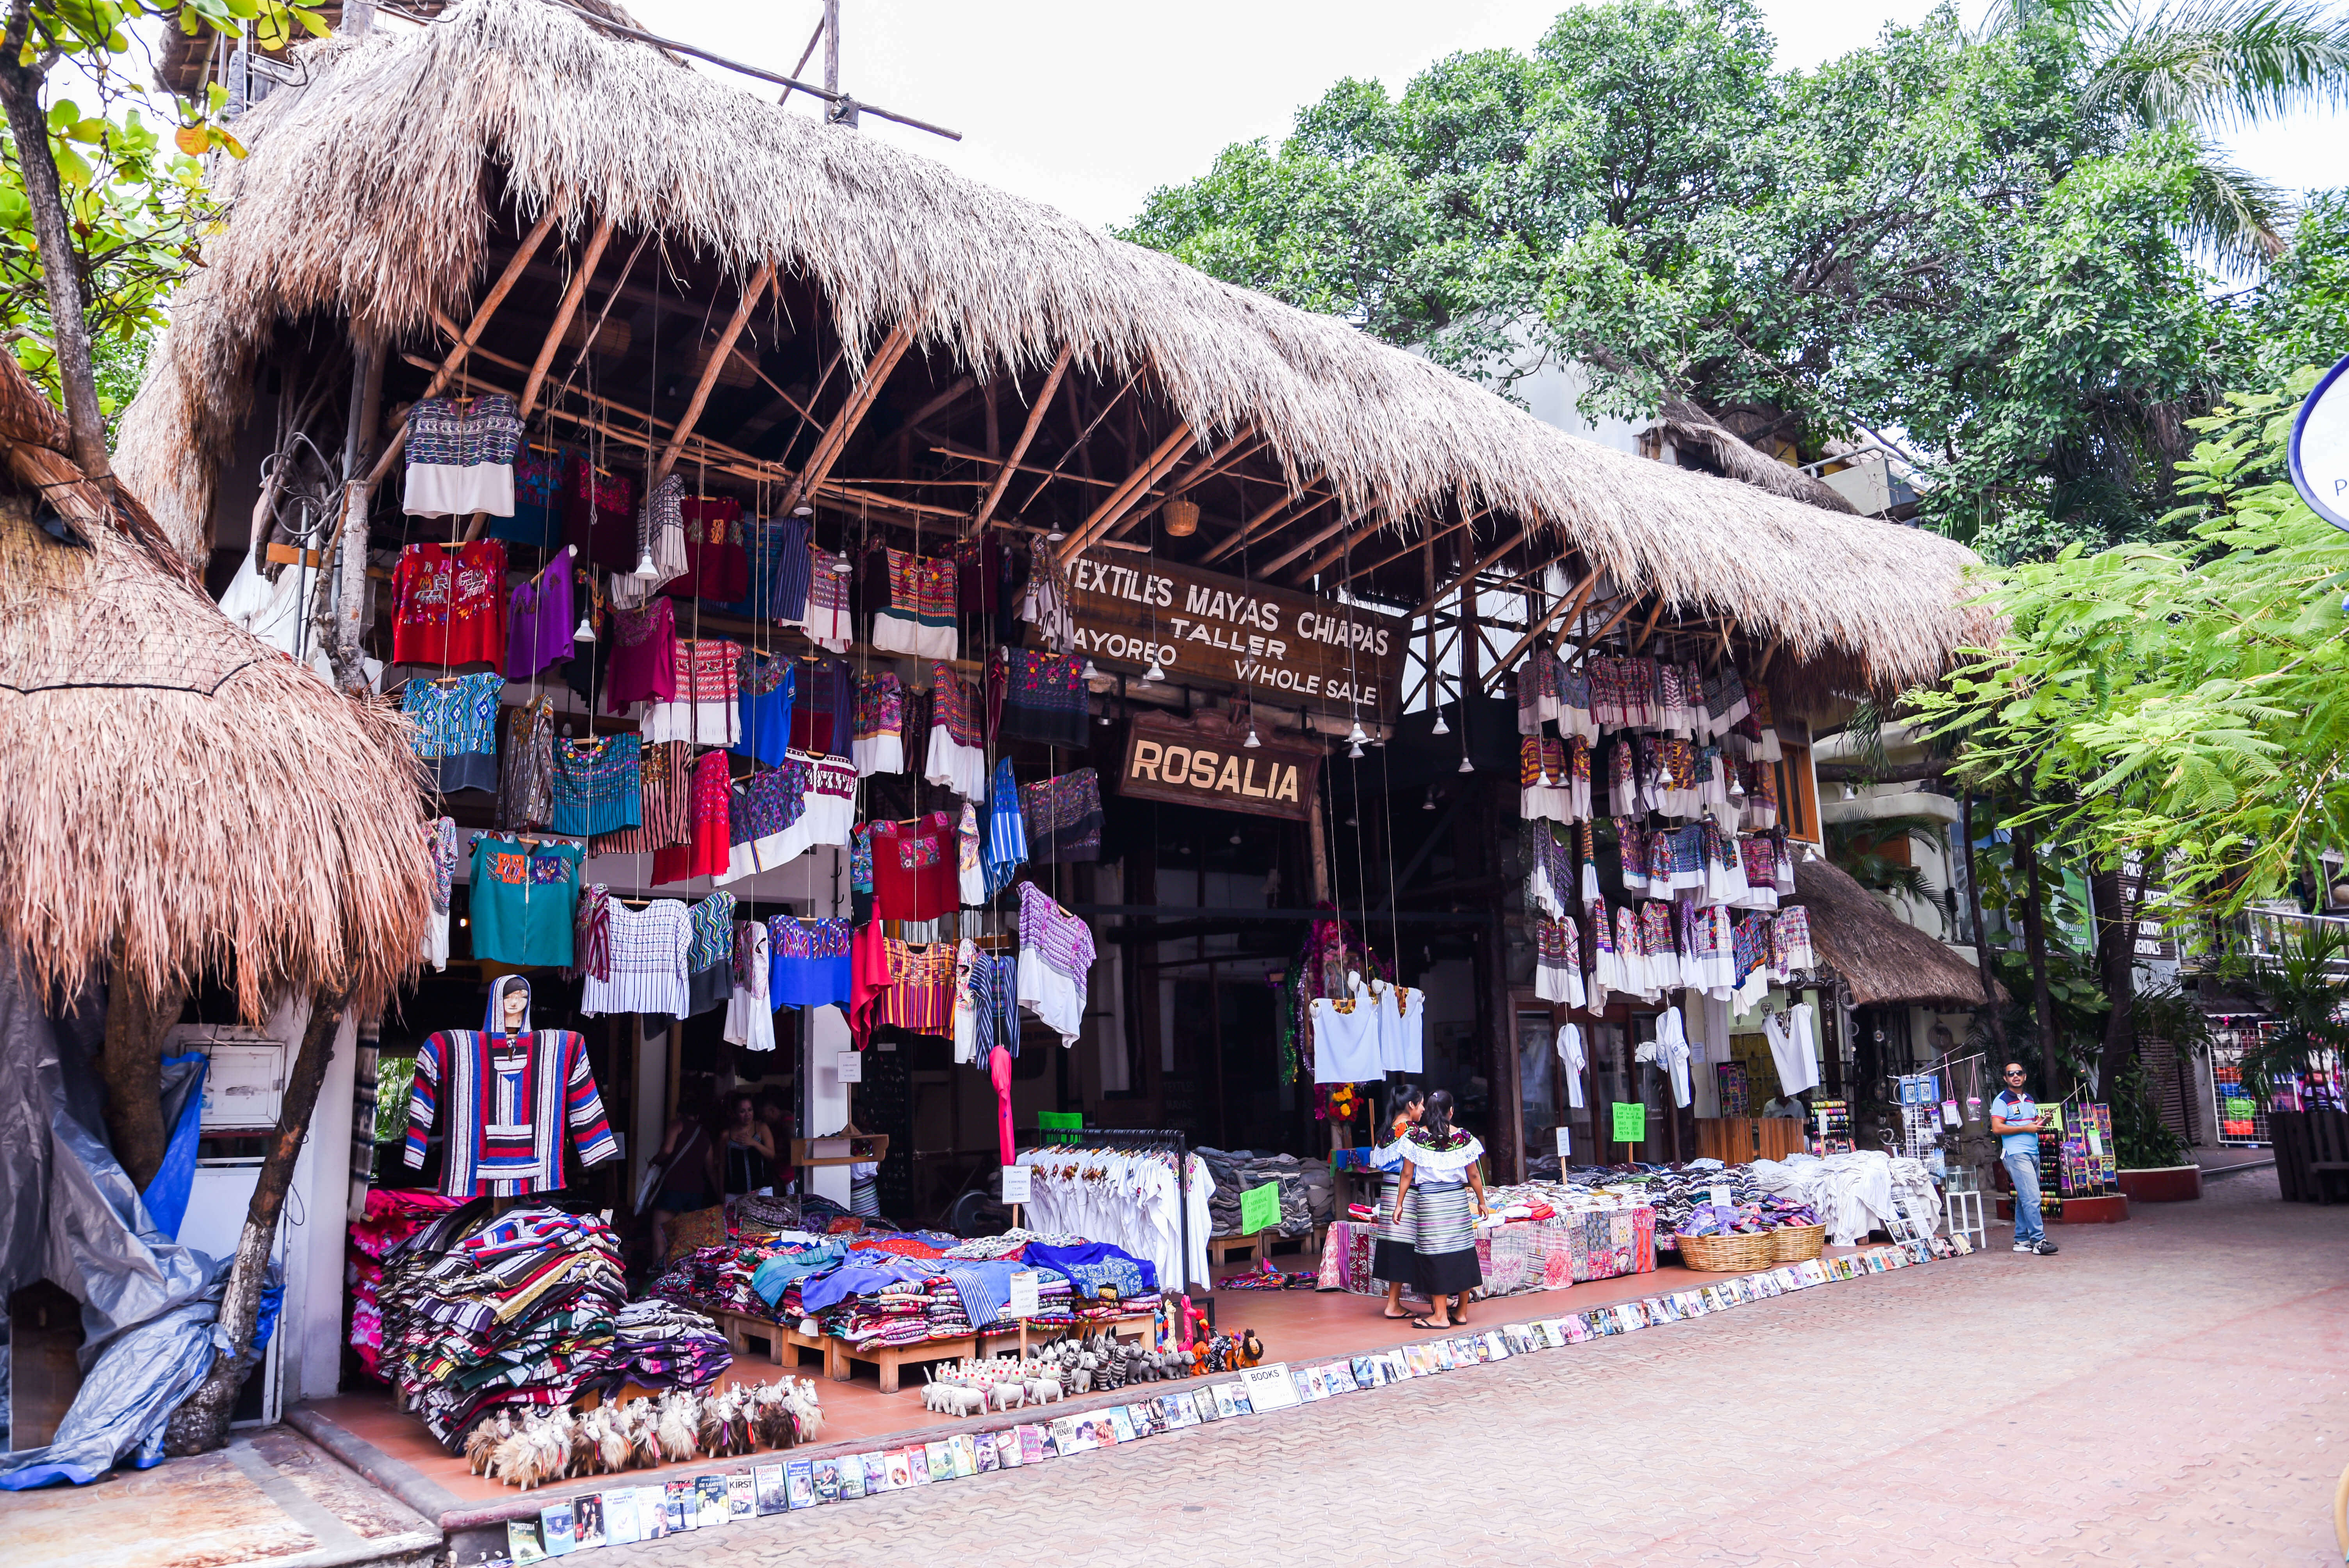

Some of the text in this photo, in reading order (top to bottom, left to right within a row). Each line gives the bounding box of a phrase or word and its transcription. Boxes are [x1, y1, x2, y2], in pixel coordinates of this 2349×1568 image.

[1185, 584, 1280, 632] MAYAS
[1297, 611, 1388, 656] CHIAPAS
[1041, 627, 1176, 666] AYOREO
[1171, 618, 1287, 660] TALLER
[1234, 659, 1377, 706] WHOLE SALE
[1131, 739, 1299, 802] ROSALIA
[1251, 1370, 1280, 1381] BOOKS
[1055, 1420, 1067, 1429] RUTH
[1057, 1427, 1073, 1437] RENDELL
[729, 1481, 752, 1489] KIRST
[515, 1522, 535, 1531] HISTORIA
